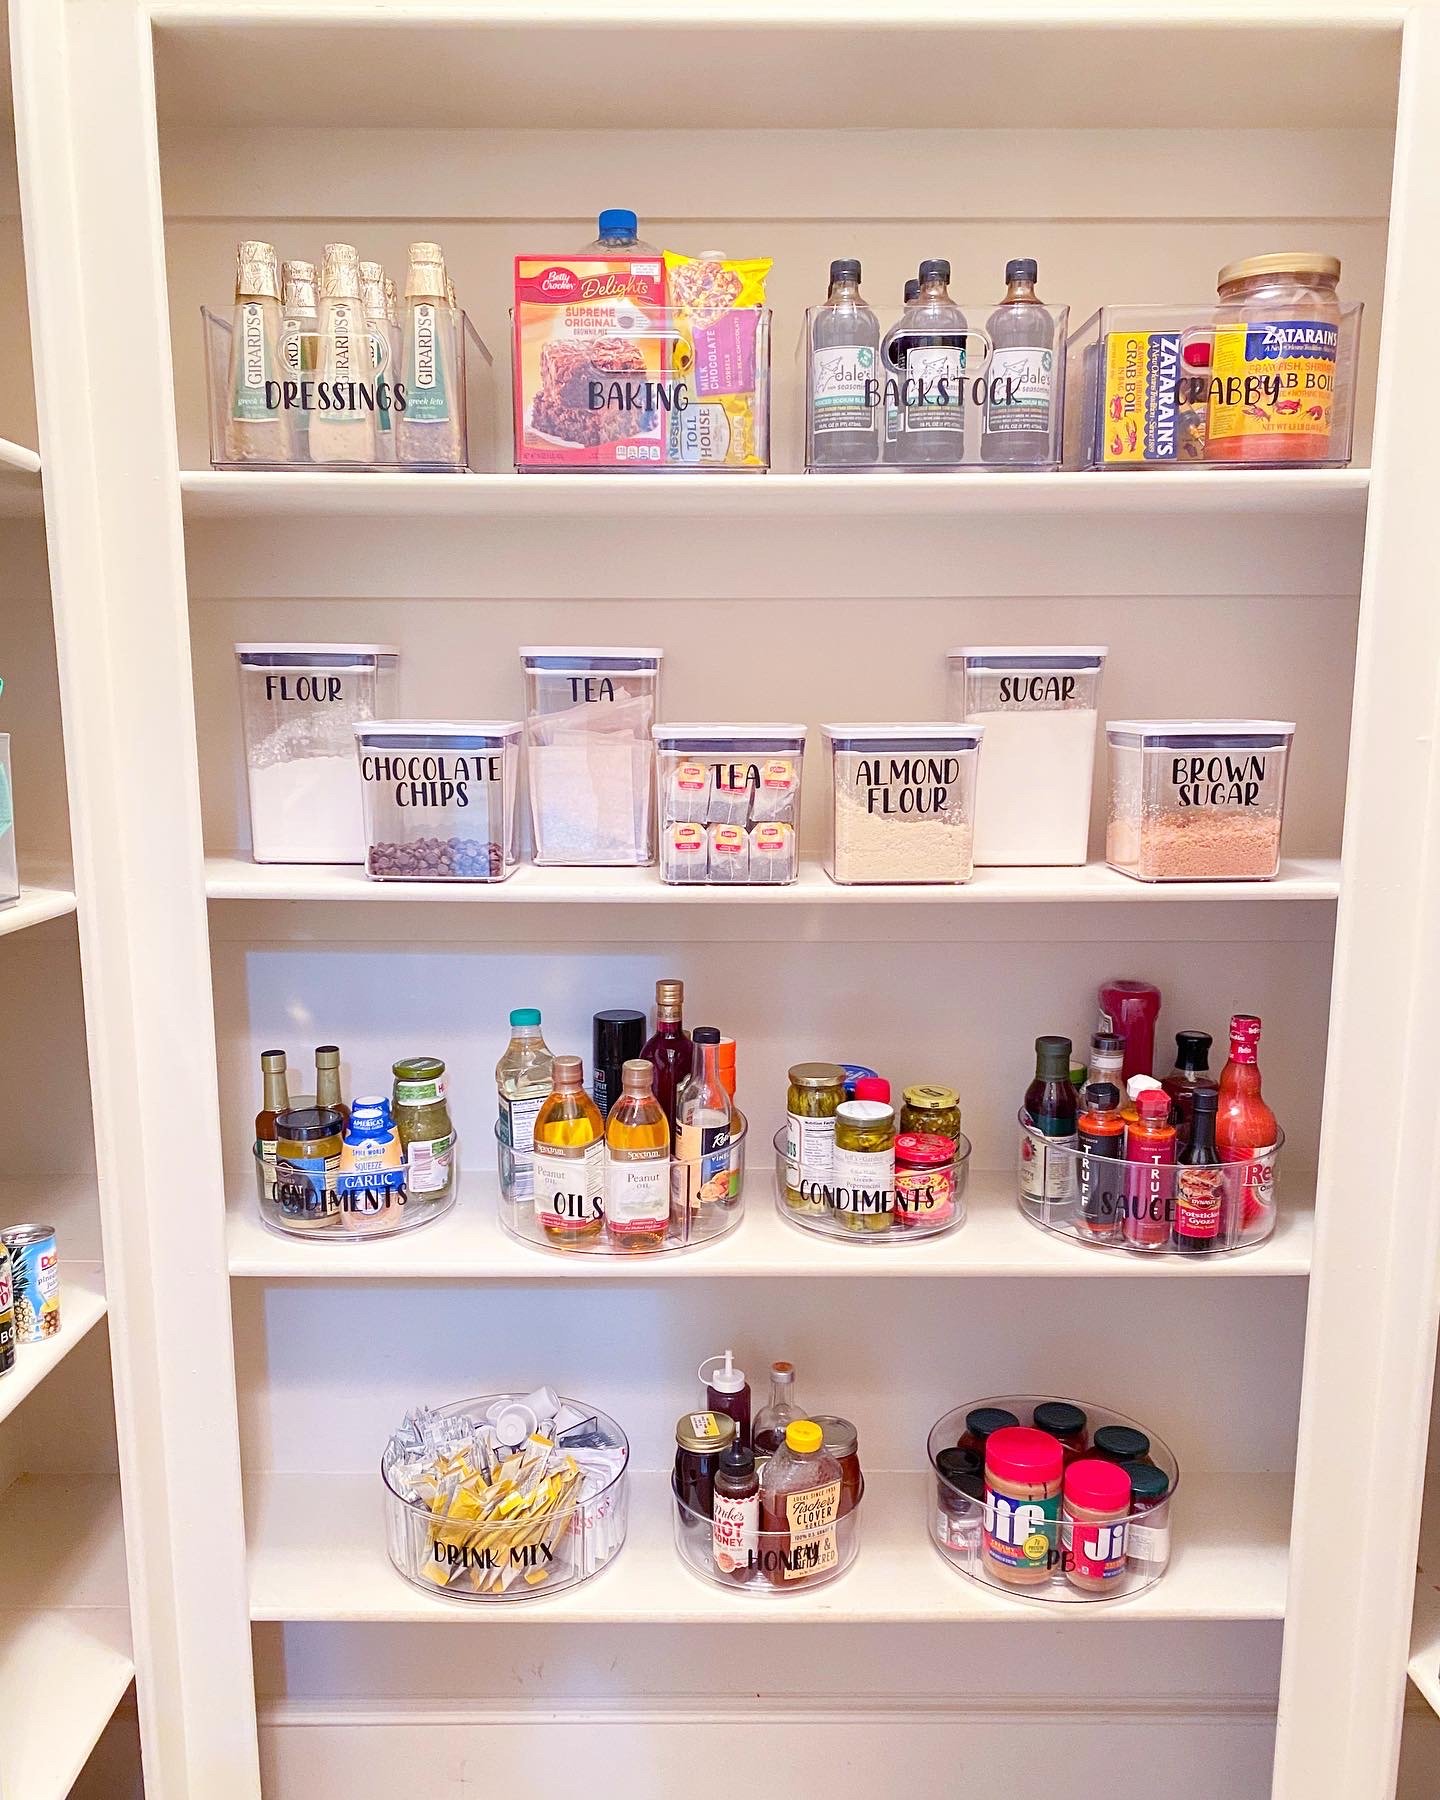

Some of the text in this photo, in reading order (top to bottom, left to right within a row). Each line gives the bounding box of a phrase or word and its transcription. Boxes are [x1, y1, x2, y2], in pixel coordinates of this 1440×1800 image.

[582, 275, 649, 300] Delights
[564, 318, 617, 328] ORIGINAL
[565, 307, 616, 318] SUPREME
[247, 316, 263, 386] GIRARD'S
[417, 316, 433, 386] GIRARD'S
[706, 329, 719, 390] CHOCOLATE
[700, 366, 710, 391] MILK
[834, 363, 870, 383] dale's
[1124, 340, 1138, 417] CRAB BOIL
[265, 380, 407, 412] DRESSINGS
[588, 381, 689, 412] BAKING
[864, 376, 1023, 408] BACKSTOCK
[1156, 338, 1180, 457] ZATARAIN'S
[1175, 376, 1280, 407] CRABBY
[686, 415, 697, 450] TOLL
[699, 408, 713, 458] HOUSE
[266, 675, 343, 702] FLOUR
[566, 677, 614, 702] TEA
[999, 676, 1075, 702] SUGAR
[362, 756, 501, 782] CHOCOLATE
[710, 763, 761, 789] TEA
[856, 758, 960, 786] ALMOND
[1172, 755, 1266, 785] BROWN
[395, 781, 469, 807] CHIPS
[867, 786, 949, 814] FLOUR
[1178, 782, 1259, 807] SUGAR
[536, 1143, 566, 1156] Spectrum
[627, 1150, 660, 1160] Spectrum
[354, 1161, 383, 1172] SQUEEZE
[537, 1166, 566, 1180] Peanut
[627, 1172, 660, 1183] Peanut
[1081, 1144, 1092, 1207] TRUFF
[344, 1172, 394, 1189] GARLIC
[272, 1181, 408, 1214] CONDIMENTS
[553, 1192, 604, 1221] OILS
[800, 1179, 935, 1213] CONDIMENTS
[1101, 1191, 1179, 1222] SAUCE
[1191, 1198, 1216, 1206] DYNASTY
[1187, 1216, 1215, 1226] Gyoza
[714, 1504, 745, 1522] Mike's
[792, 1494, 835, 1515] Fischer's
[796, 1506, 832, 1526] CLOVER
[433, 1540, 554, 1569] DRINK MIX
[823, 1537, 831, 1551] &
[747, 1549, 819, 1572] HONEY
[1046, 1549, 1076, 1573] PB
